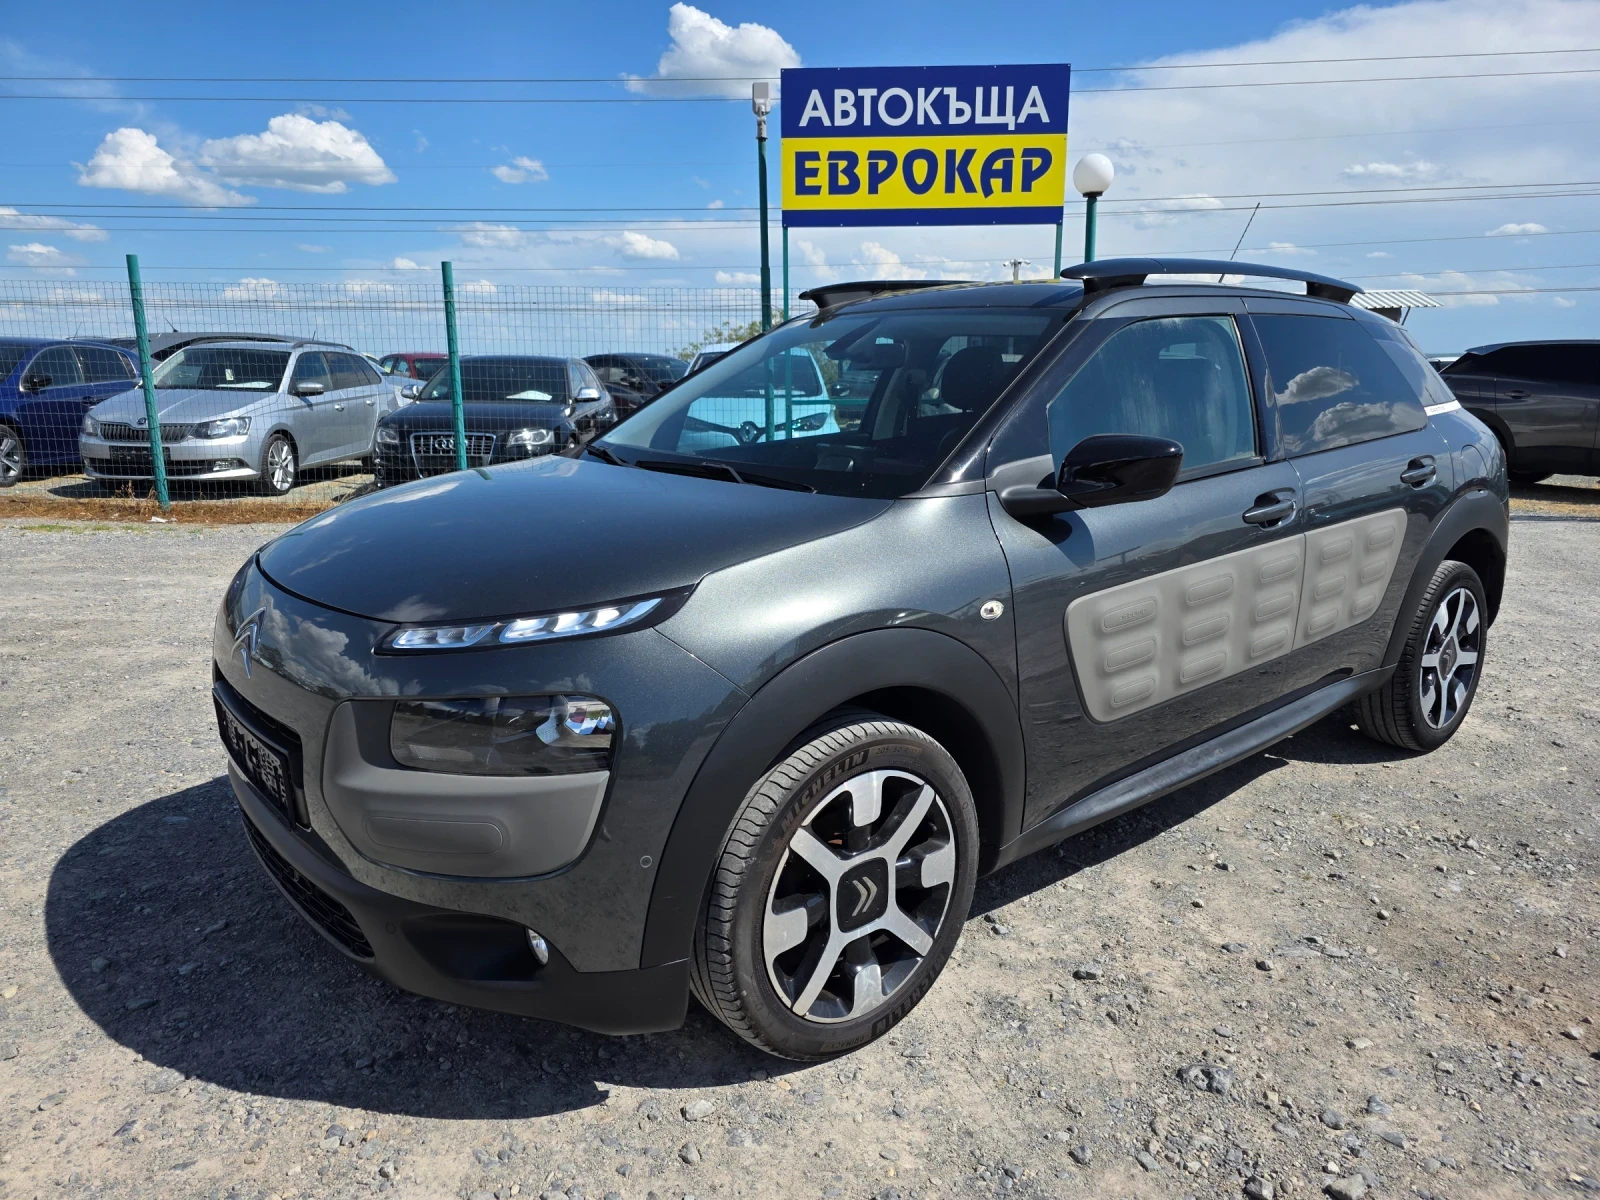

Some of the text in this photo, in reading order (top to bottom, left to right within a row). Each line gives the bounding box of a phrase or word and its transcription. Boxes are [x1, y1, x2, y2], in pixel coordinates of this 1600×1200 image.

[799, 86, 1050, 130] АВТОКЪЩА
[795, 147, 1053, 199] ЕВРОКАР
[781, 751, 864, 834] MICHELIN
[876, 951, 946, 1036] MICHELIN
